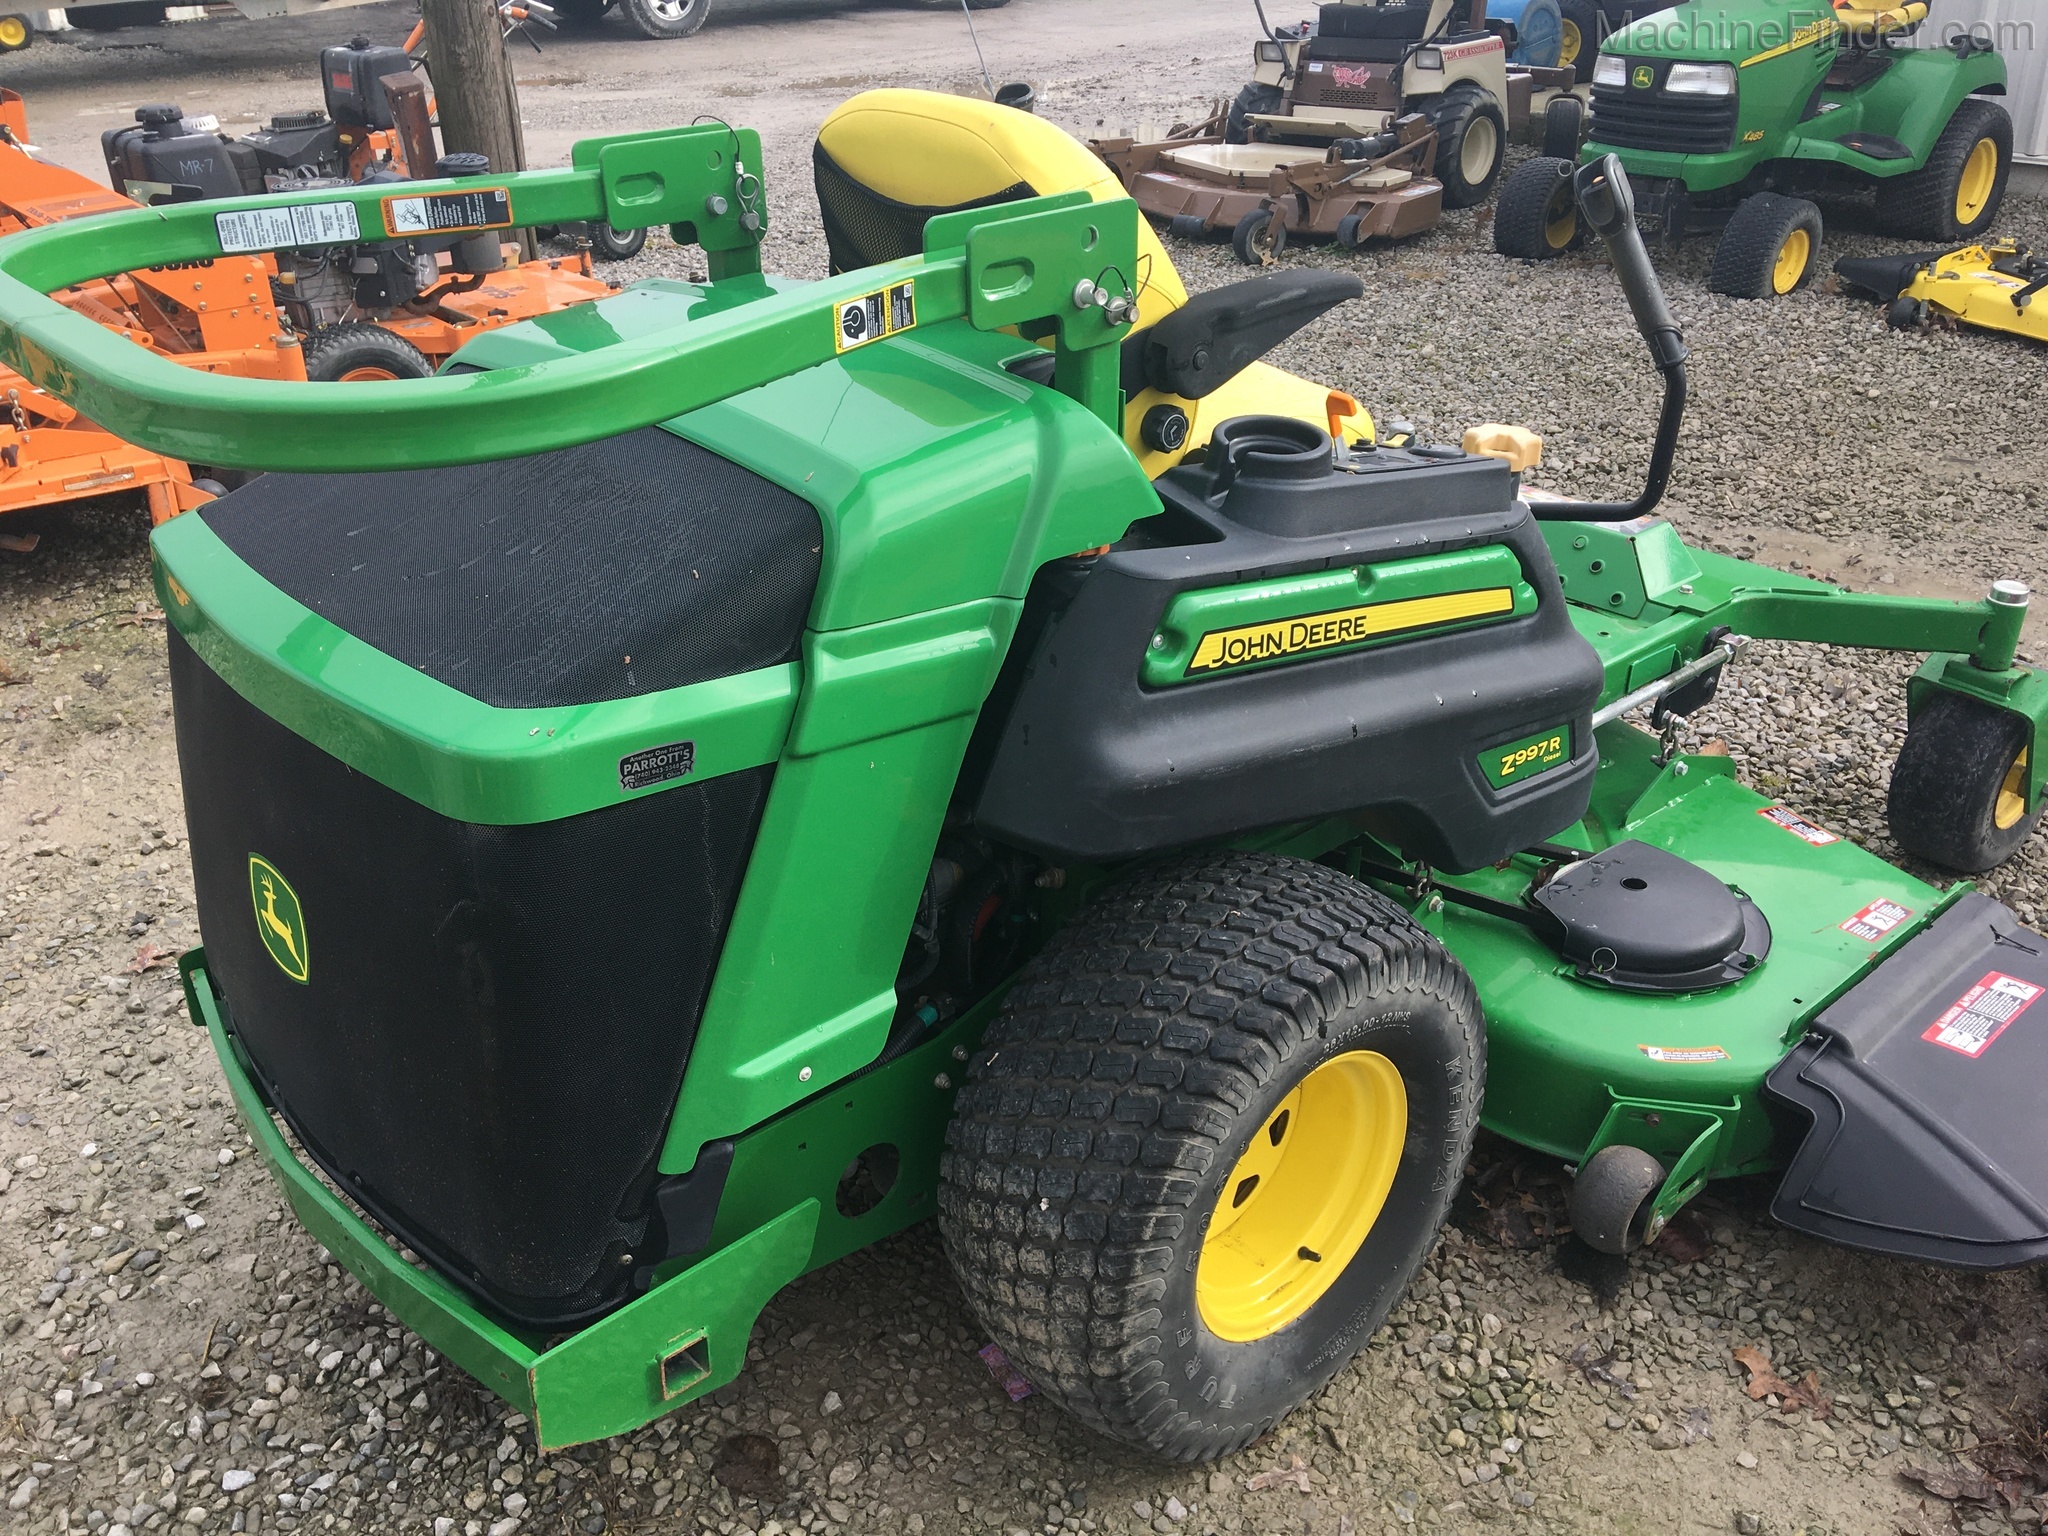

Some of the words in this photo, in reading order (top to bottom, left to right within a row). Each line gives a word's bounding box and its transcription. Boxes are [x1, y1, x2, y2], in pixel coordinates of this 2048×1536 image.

[1793, 26, 1812, 42] JOHN
[1812, 17, 1831, 33] DEERE
[1742, 130, 1765, 143] X485
[384, 199, 393, 228] WARNING
[1211, 631, 1283, 665] JOHN
[1289, 615, 1368, 650] DEERE
[624, 749, 690, 775] PARROTT'S
[629, 752, 654, 762] Another
[669, 745, 685, 753] From
[1543, 751, 1561, 763] Diesel
[666, 771, 681, 779] Ohio
[1431, 1056, 1464, 1192] KENDA
